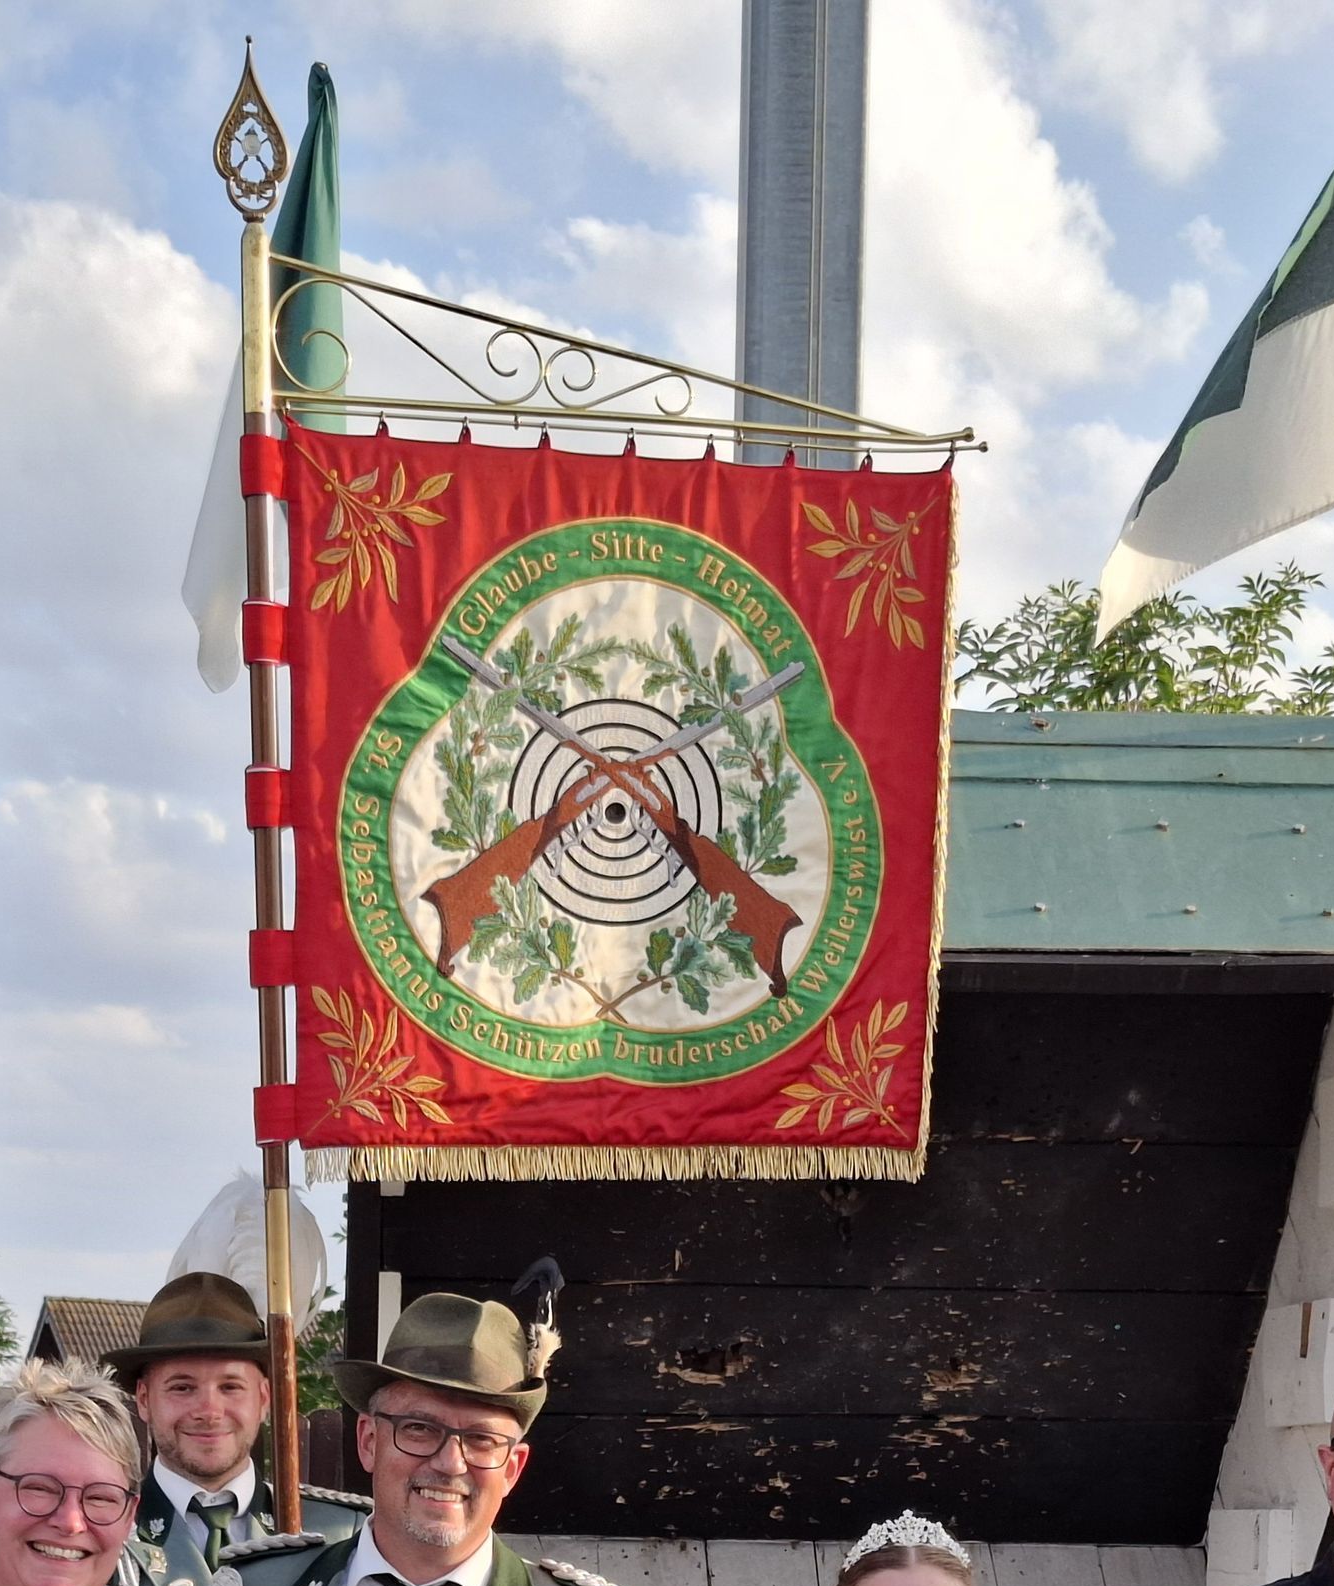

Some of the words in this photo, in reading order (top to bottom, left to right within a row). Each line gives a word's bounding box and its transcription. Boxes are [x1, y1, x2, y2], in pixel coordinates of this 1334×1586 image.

[457, 550, 558, 637] Glaube
[589, 530, 664, 563] Sitte
[694, 553, 794, 659] Heimat
[365, 729, 404, 774] St.
[349, 791, 444, 1013] Sebastianus
[798, 814, 867, 993] Weilerswist
